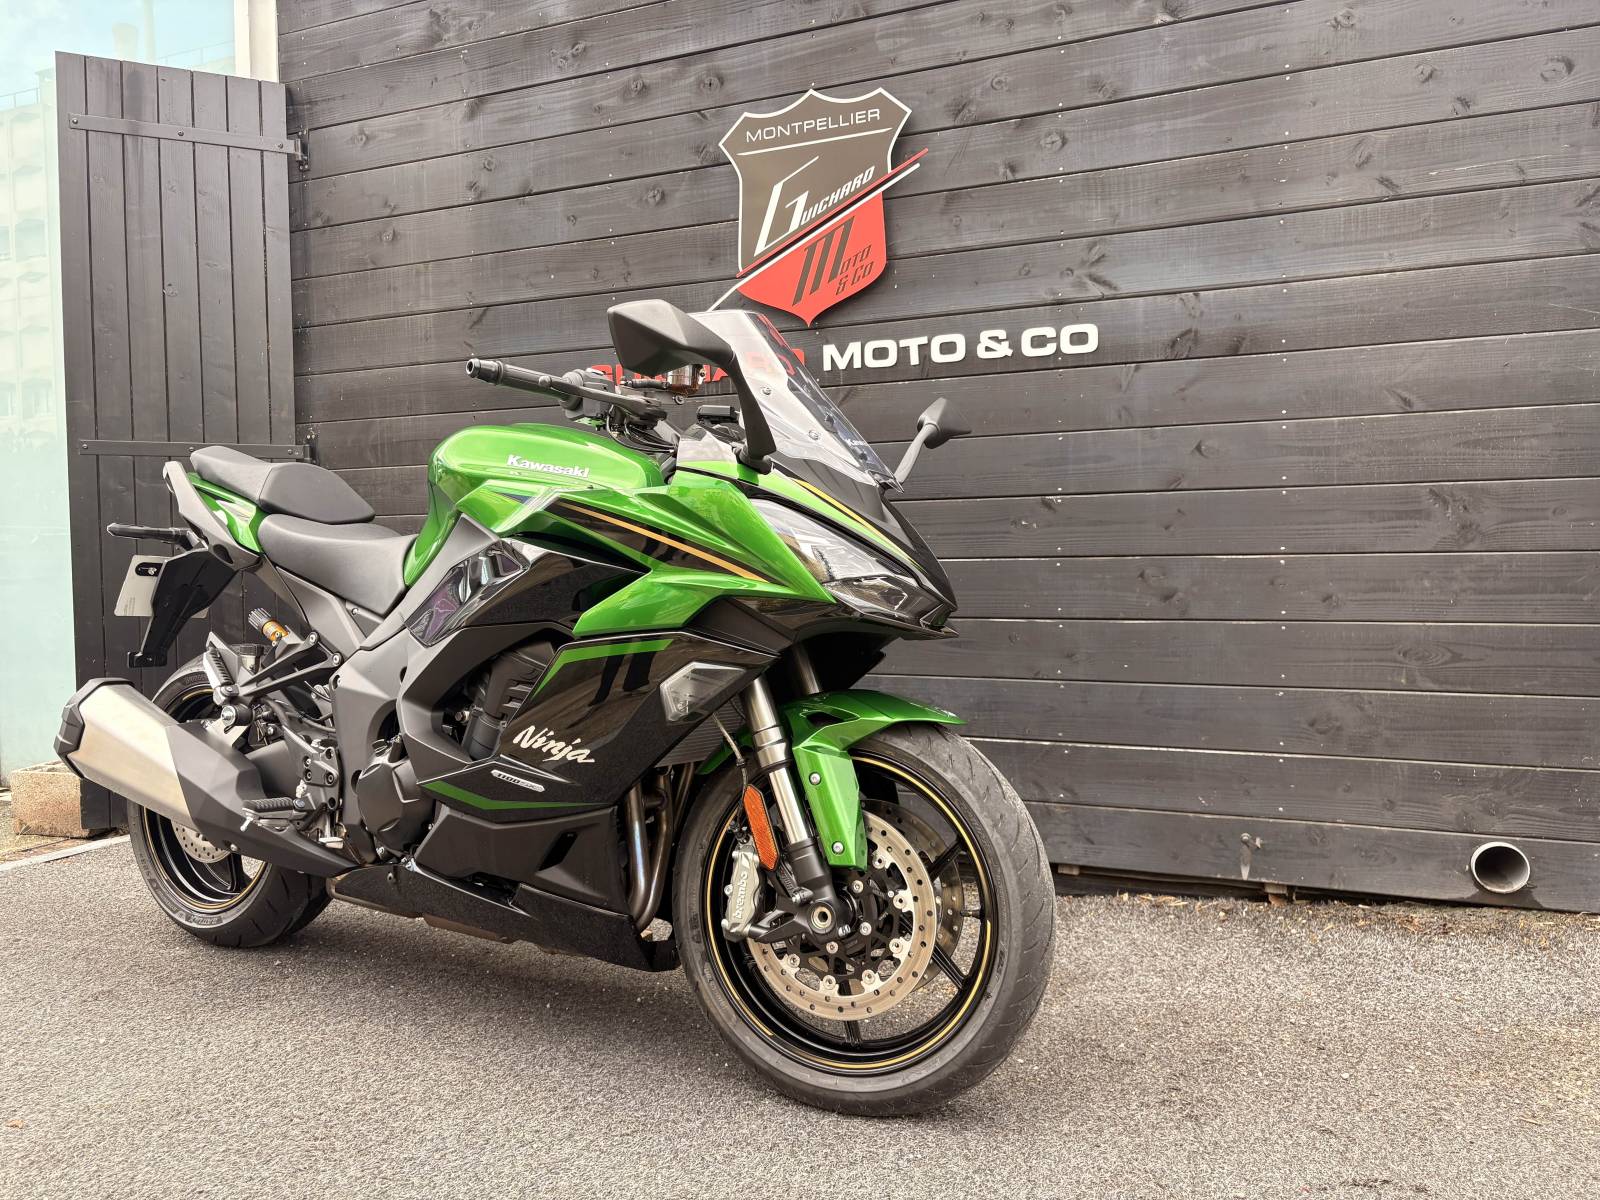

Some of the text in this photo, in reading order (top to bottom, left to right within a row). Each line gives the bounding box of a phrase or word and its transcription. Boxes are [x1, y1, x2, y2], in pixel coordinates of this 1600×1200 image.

[746, 108, 881, 143] MONTPELLIER
[753, 155, 876, 258] GUICHARD
[850, 260, 875, 287] CO
[822, 333, 966, 372] MOTO
[976, 329, 1013, 359] &
[1021, 323, 1099, 357] CO
[506, 453, 590, 479] Kawasaki
[512, 725, 596, 763] Ninja
[733, 872, 748, 919] brembo
